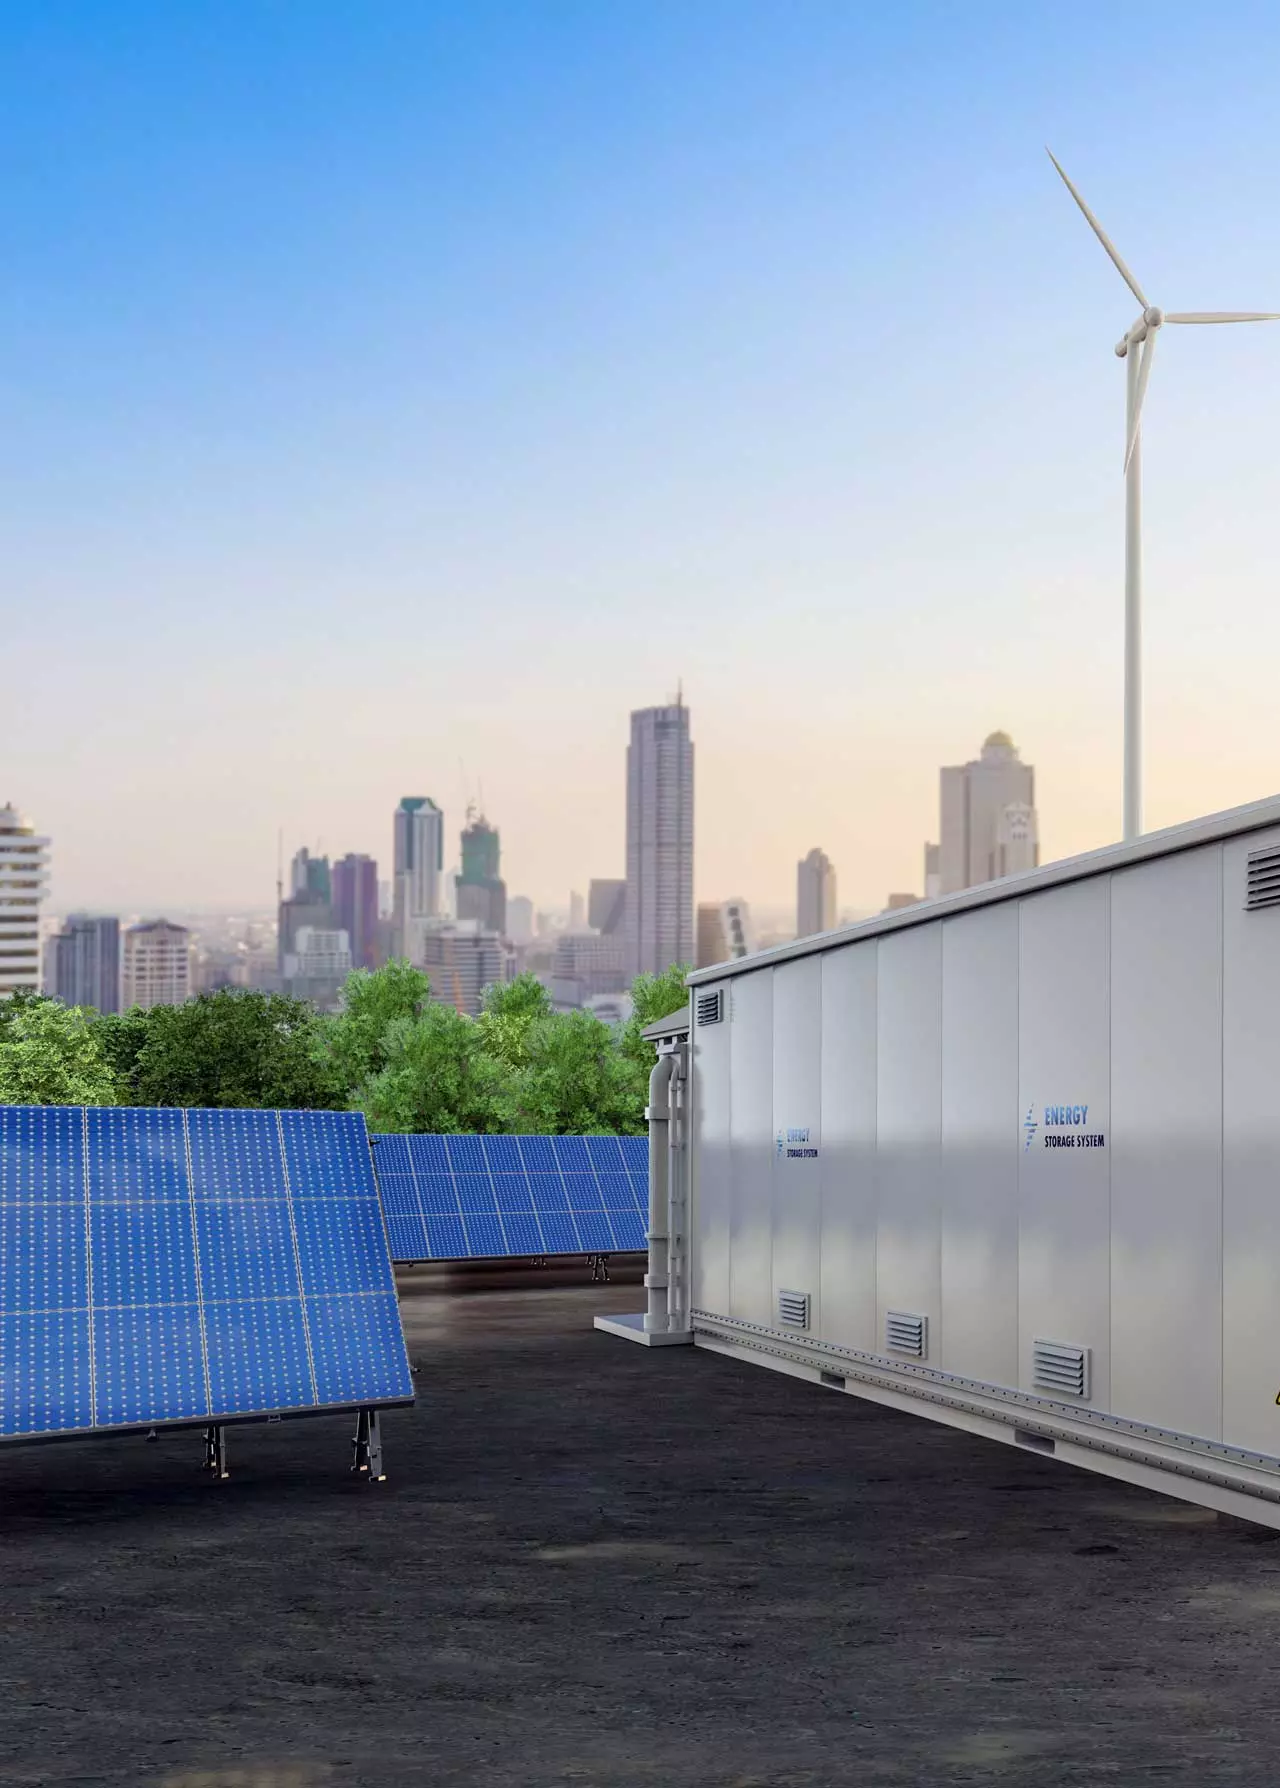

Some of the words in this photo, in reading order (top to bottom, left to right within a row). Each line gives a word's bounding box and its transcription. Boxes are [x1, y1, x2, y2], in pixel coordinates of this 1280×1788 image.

[1045, 1105, 1088, 1125] ENERGY
[1045, 1135, 1075, 1147] STORAGE
[1077, 1135, 1104, 1147] SYSTEM
